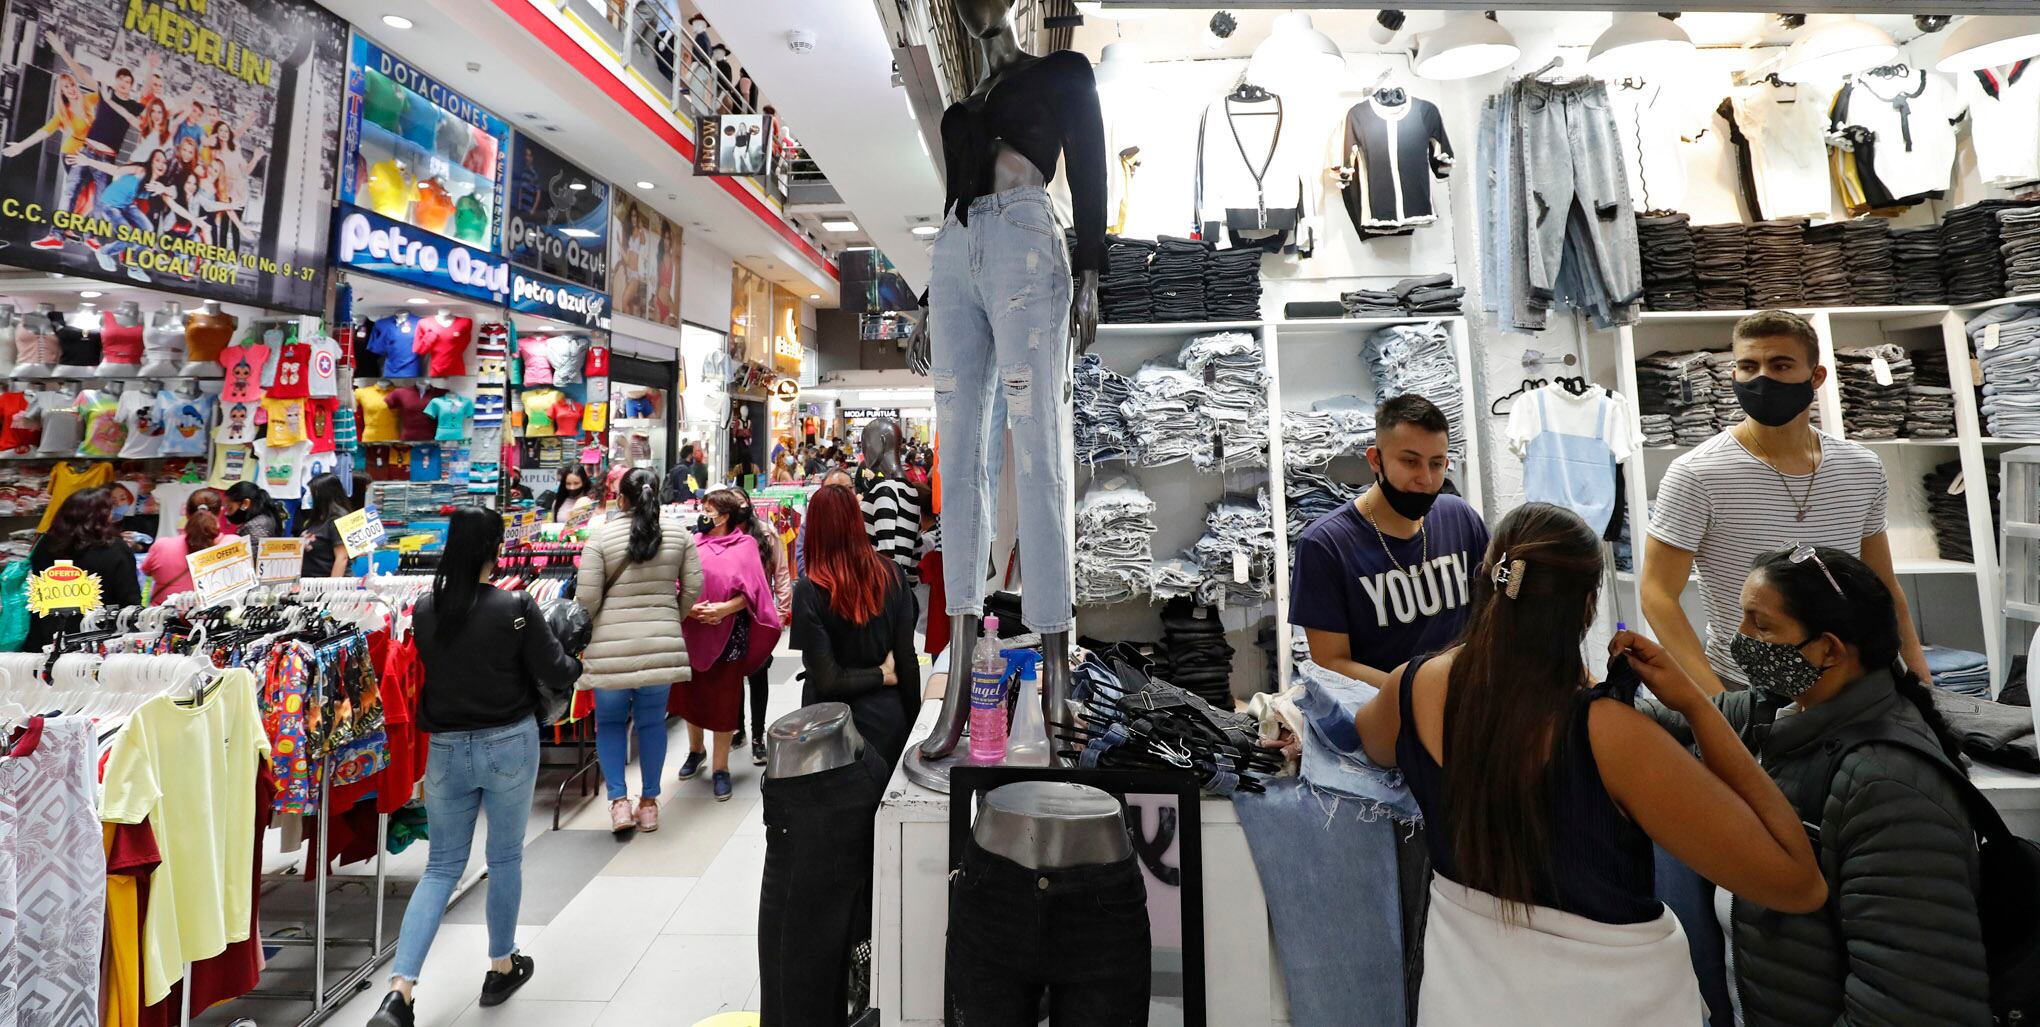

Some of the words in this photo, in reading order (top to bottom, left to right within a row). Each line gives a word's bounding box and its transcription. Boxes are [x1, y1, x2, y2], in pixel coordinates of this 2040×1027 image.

[124, 0, 273, 86] MEDELLIN
[381, 52, 489, 131] DOTACIONES
[2, 198, 47, 224] C.C.
[53, 209, 113, 238] GRAN
[117, 224, 156, 247] SAN
[159, 235, 238, 265] CARRERA
[240, 252, 256, 269] 10
[258, 257, 279, 275] No.
[283, 264, 291, 279] 9
[301, 267, 316, 282] 37
[340, 213, 439, 272] Petro
[509, 216, 563, 259] Petro
[125, 247, 194, 277] LOCAL
[200, 264, 237, 286] 1081
[513, 276, 554, 304] Petro
[844, 410, 865, 418] MODA
[216, 546, 240, 559] OFERTA
[1359, 551, 1470, 627] YOUTH
